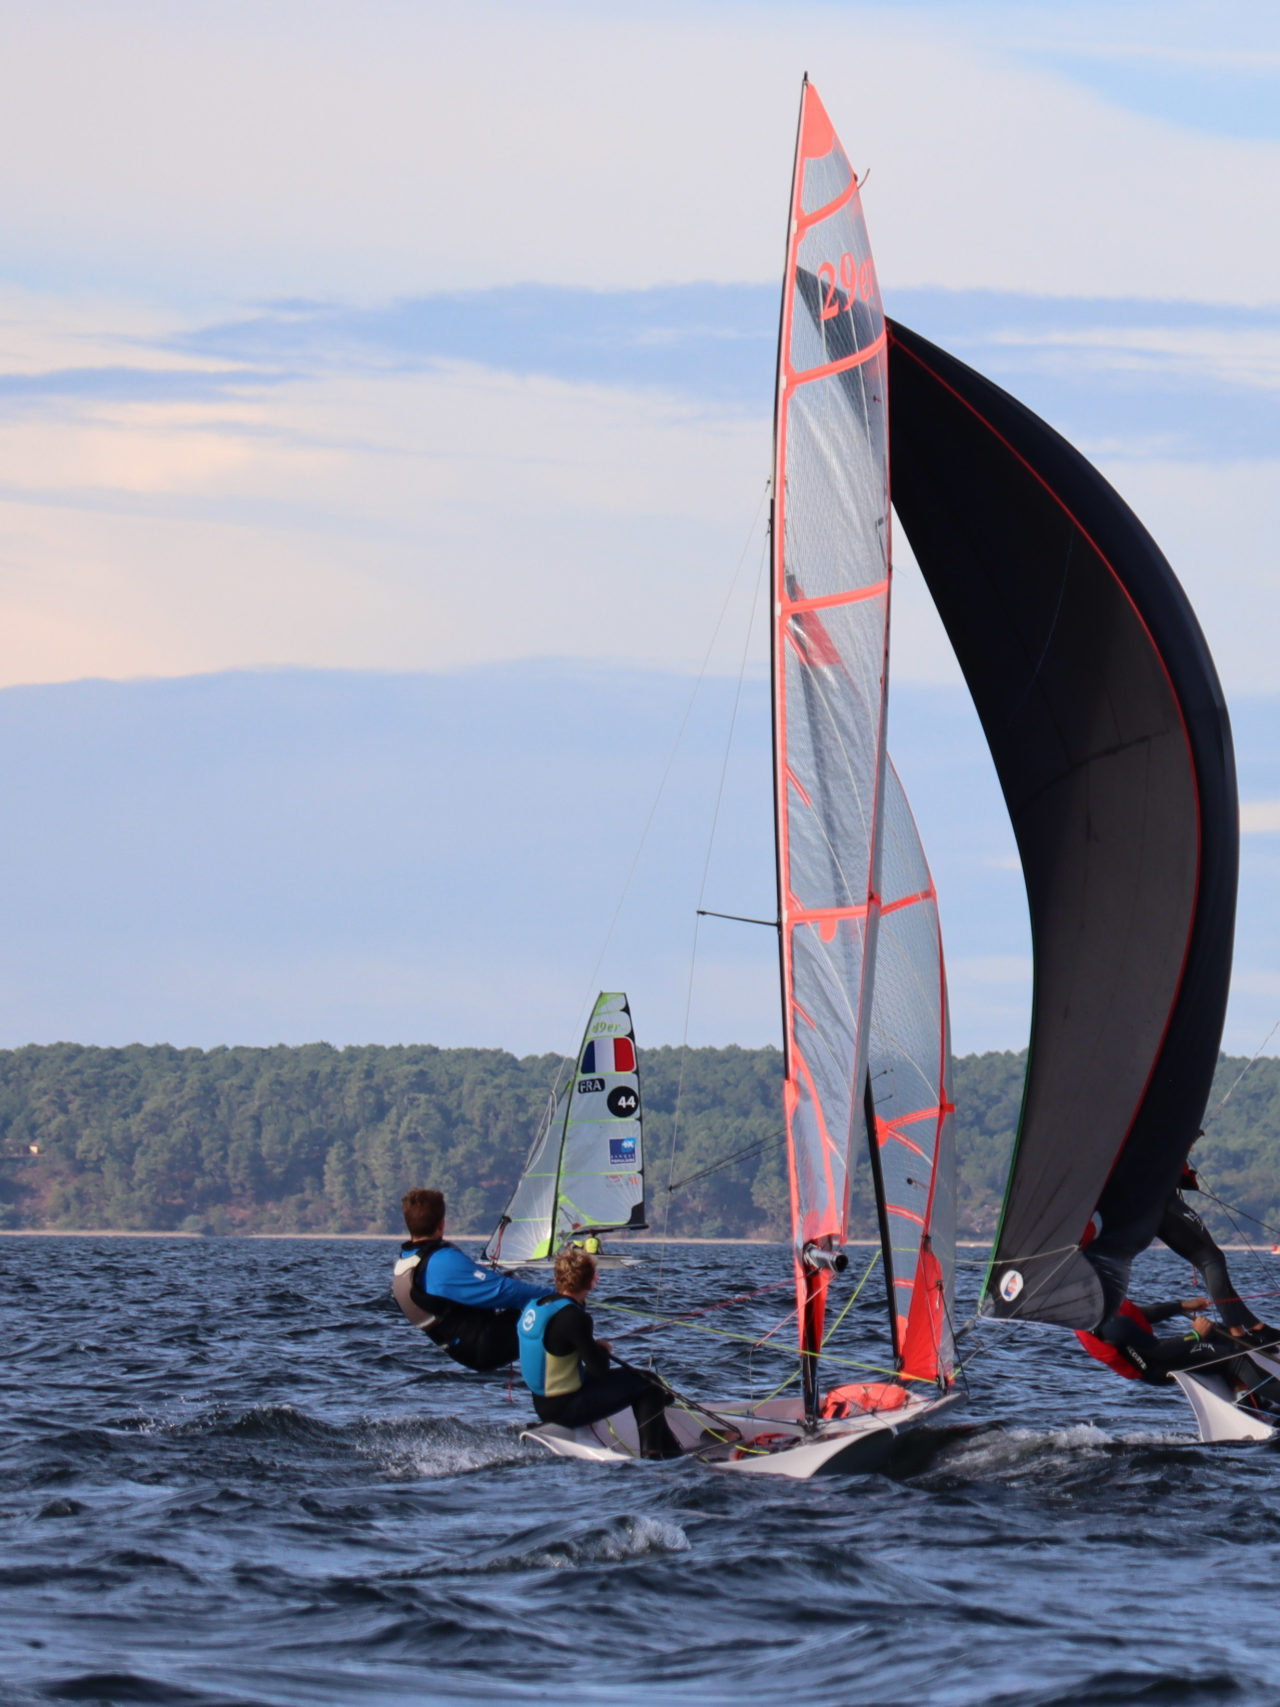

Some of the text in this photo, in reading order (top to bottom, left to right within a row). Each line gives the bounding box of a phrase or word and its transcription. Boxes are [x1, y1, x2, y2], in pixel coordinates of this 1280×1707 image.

[817, 252, 873, 321] 29er
[580, 1080, 602, 1092] FRA
[617, 1095, 636, 1108] 44
